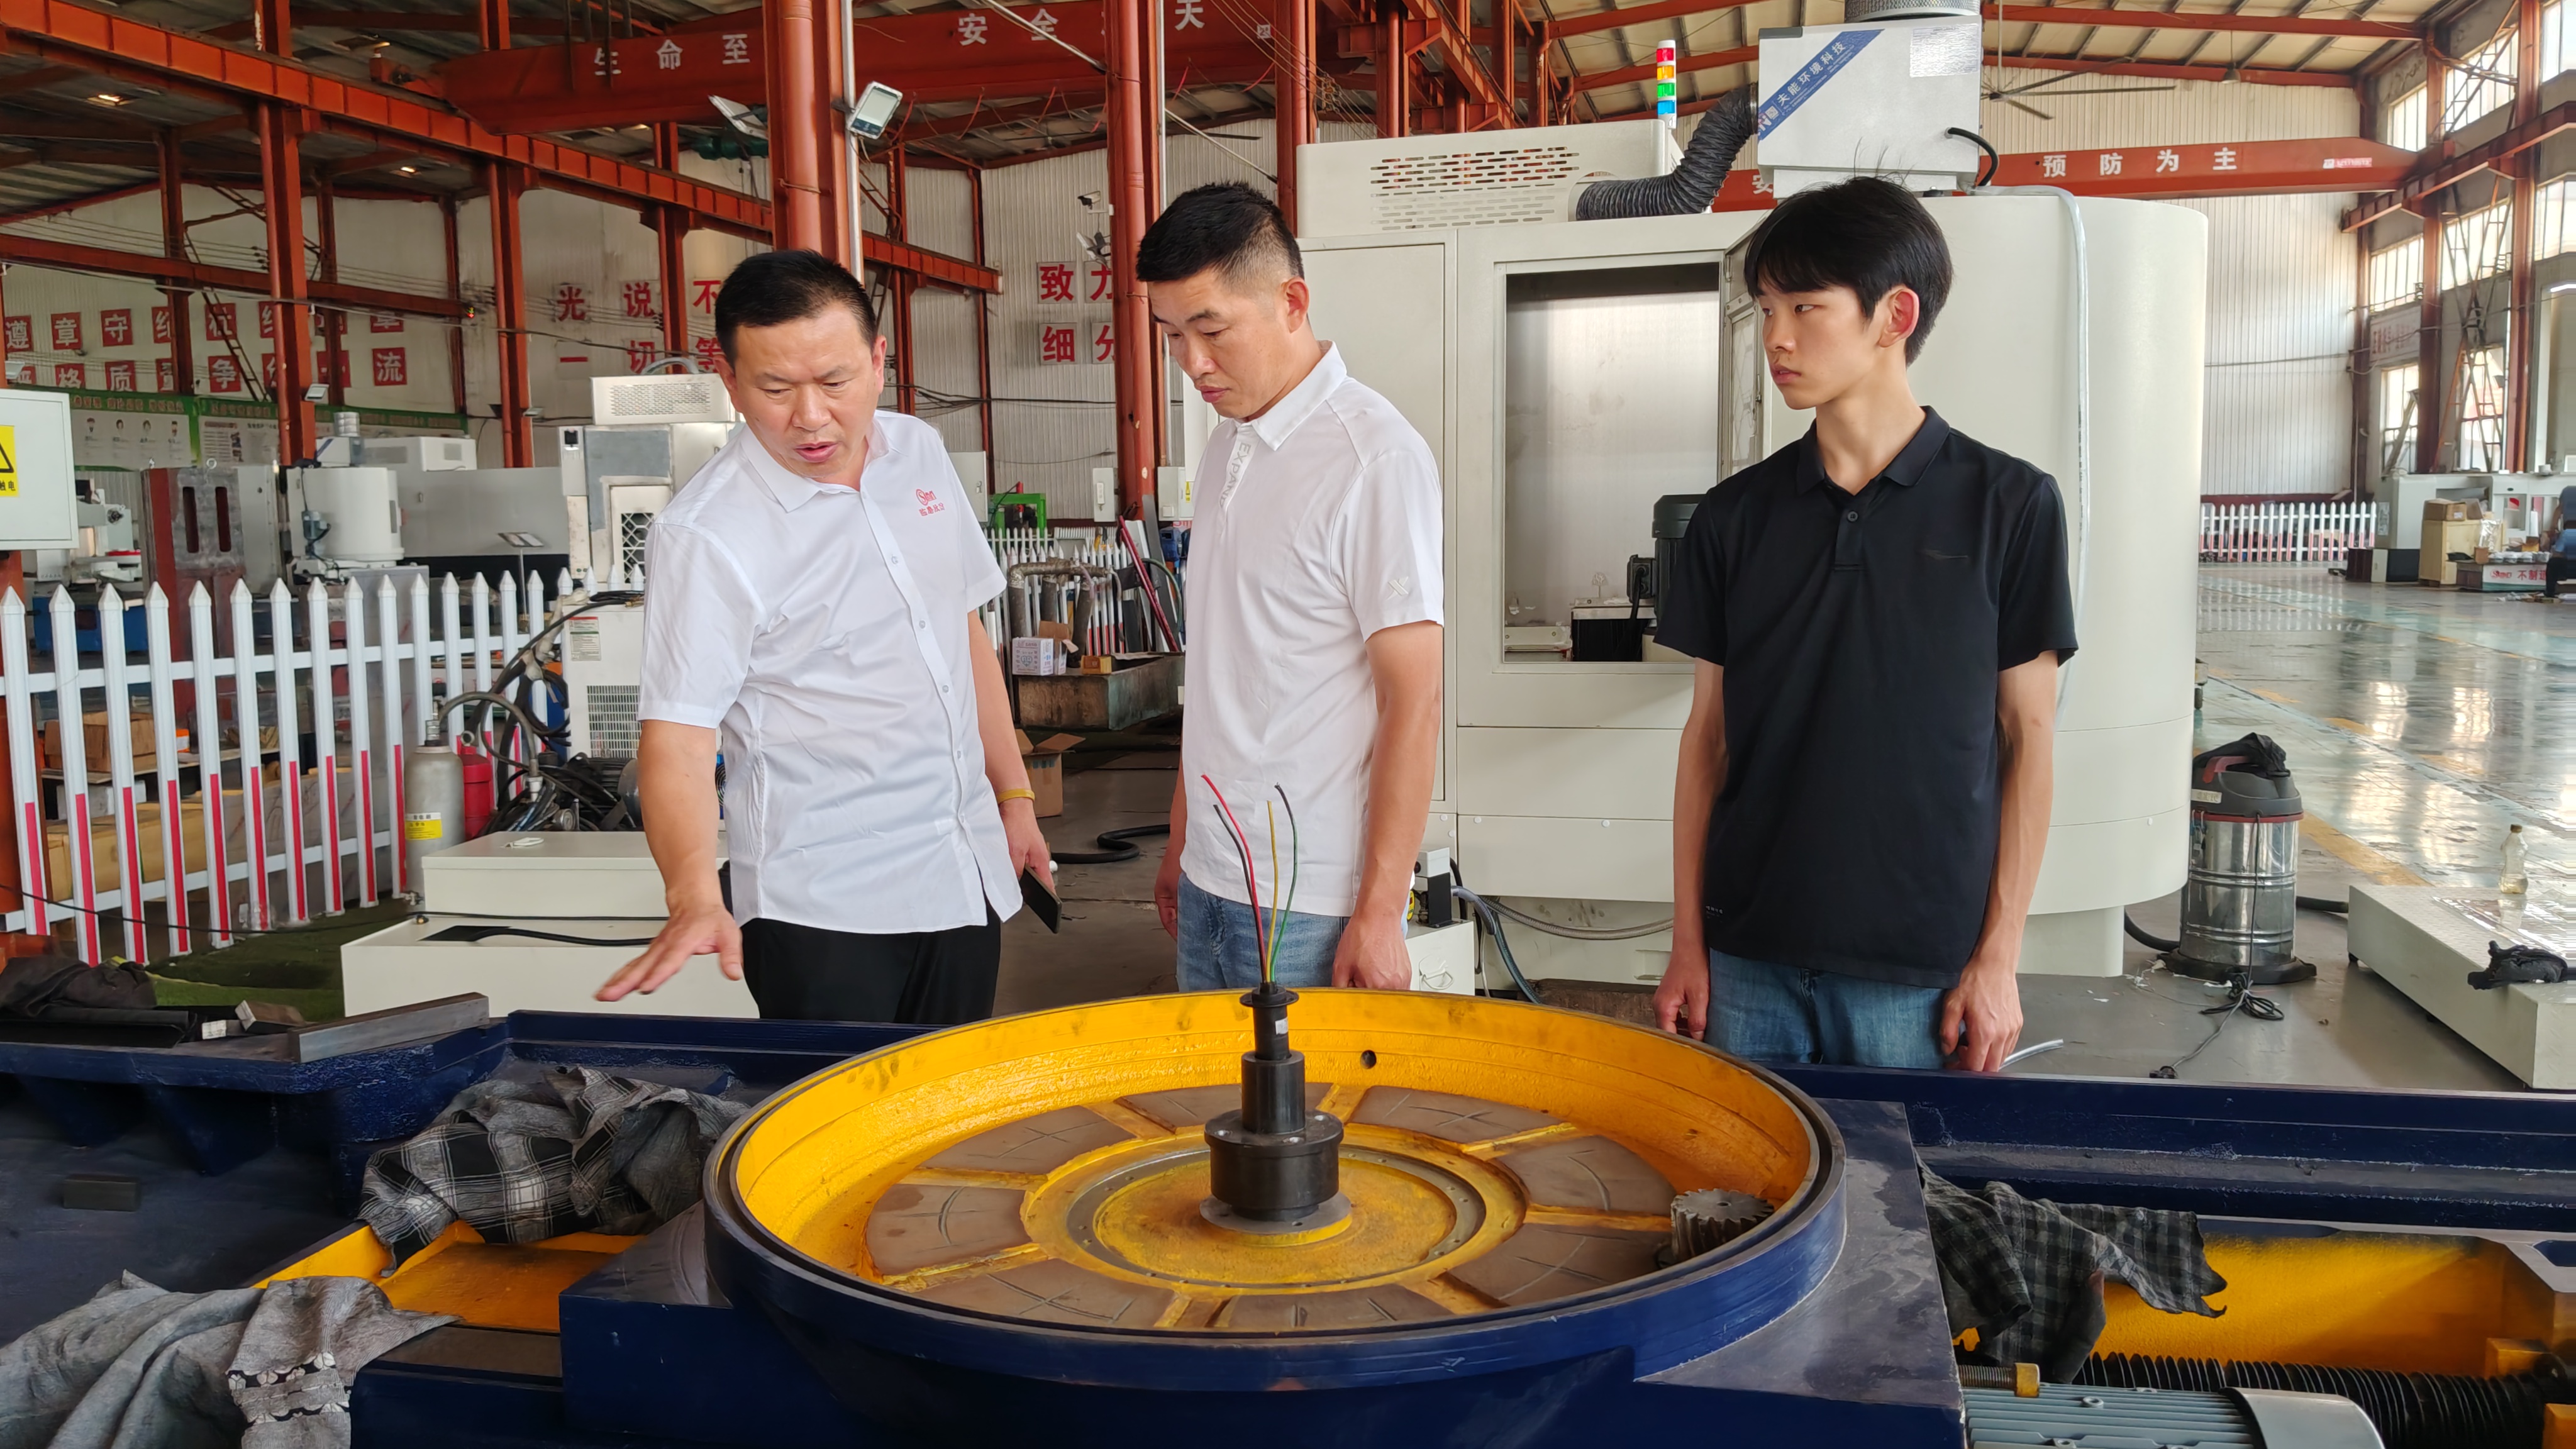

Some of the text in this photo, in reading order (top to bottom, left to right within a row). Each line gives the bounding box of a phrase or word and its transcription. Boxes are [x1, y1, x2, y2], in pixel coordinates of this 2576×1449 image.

[2043, 147, 2238, 178] 预防为主
[557, 280, 722, 321] 光说不
